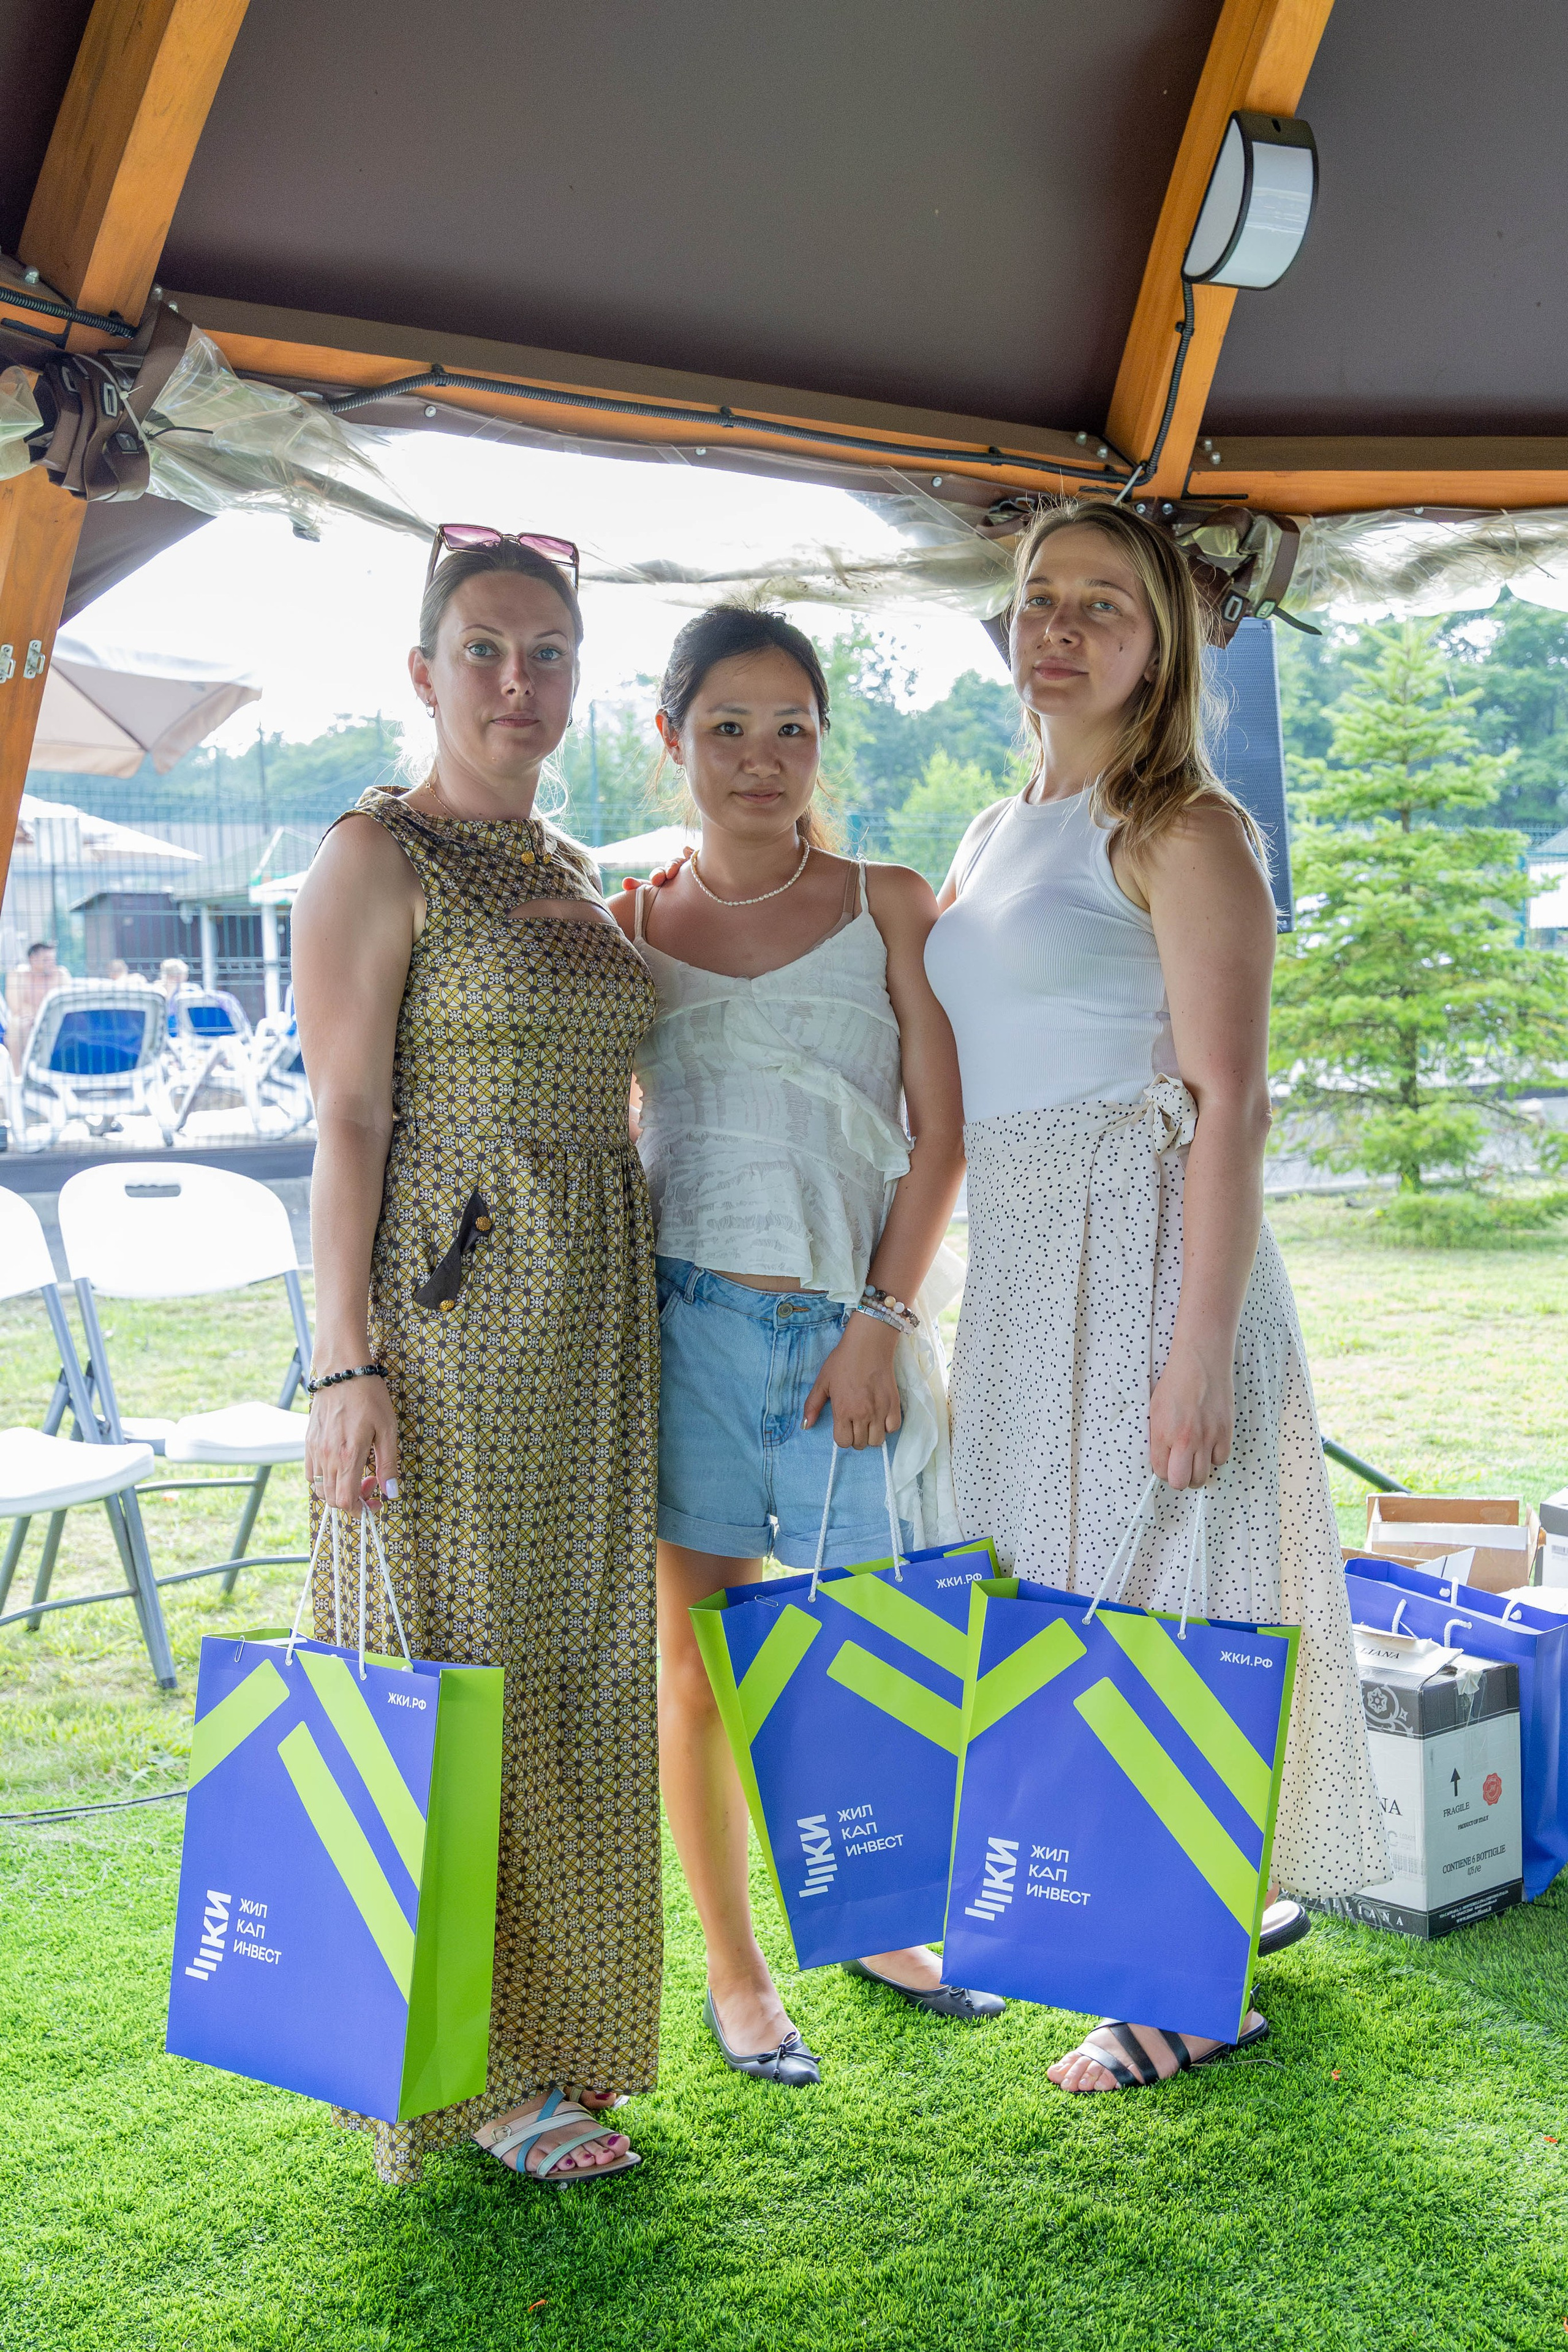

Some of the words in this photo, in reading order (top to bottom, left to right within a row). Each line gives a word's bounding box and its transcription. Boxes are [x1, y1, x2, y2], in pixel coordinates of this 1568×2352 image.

[935, 1572, 982, 1589] ЖКИ.РФ
[1219, 1650, 1273, 1668] ЖКИ.РФ
[1355, 1646, 1400, 1659] LIANA
[388, 1692, 427, 1710] ЖКИ.РФ
[837, 1804, 873, 1822] ЖИЛ
[1443, 1802, 1470, 1817] FRAGILE
[841, 1822, 878, 1840] КАП
[845, 1834, 904, 1857] ИНВЕСТ
[1030, 1844, 1069, 1863] ЖИЛ
[1442, 1856, 1471, 1874] CONTIENE
[1472, 1855, 1476, 1863] 6
[1476, 1844, 1506, 1862] BOTTIGLIE
[1028, 1864, 1068, 1883] КАП
[1026, 1883, 1091, 1905] ИНВЕСТ
[239, 1898, 268, 1918] ЖИЛ
[236, 1918, 265, 1939] КАП
[233, 1939, 282, 1965] ИНВЕСТ
